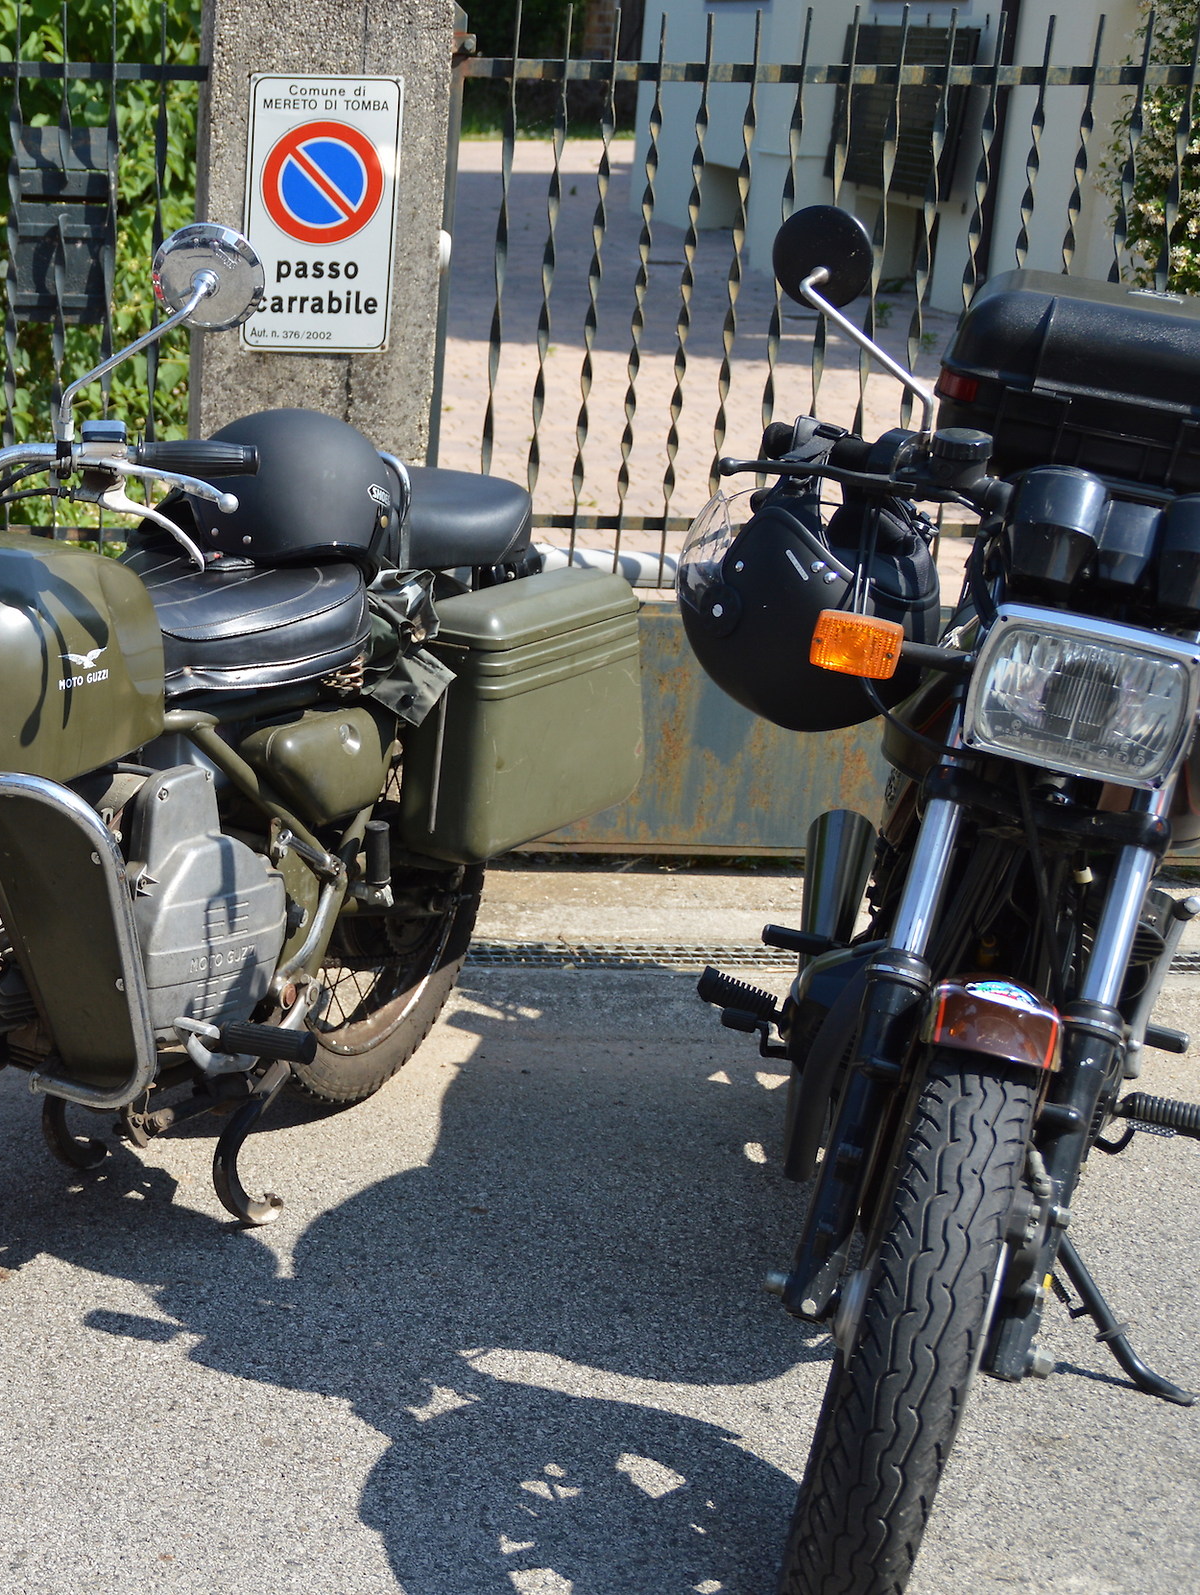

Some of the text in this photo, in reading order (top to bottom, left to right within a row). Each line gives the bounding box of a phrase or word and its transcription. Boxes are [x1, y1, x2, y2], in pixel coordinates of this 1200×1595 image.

[289, 84, 367, 97] Comune di
[263, 98, 390, 111] MERETO DI TOMBA
[276, 260, 359, 283] passo
[256, 290, 378, 314] carrabile
[250, 327, 332, 340] Aut. n. 376/2002
[58, 668, 109, 691] MOTO GUZZI
[189, 943, 258, 973] MOTO GUZZ
